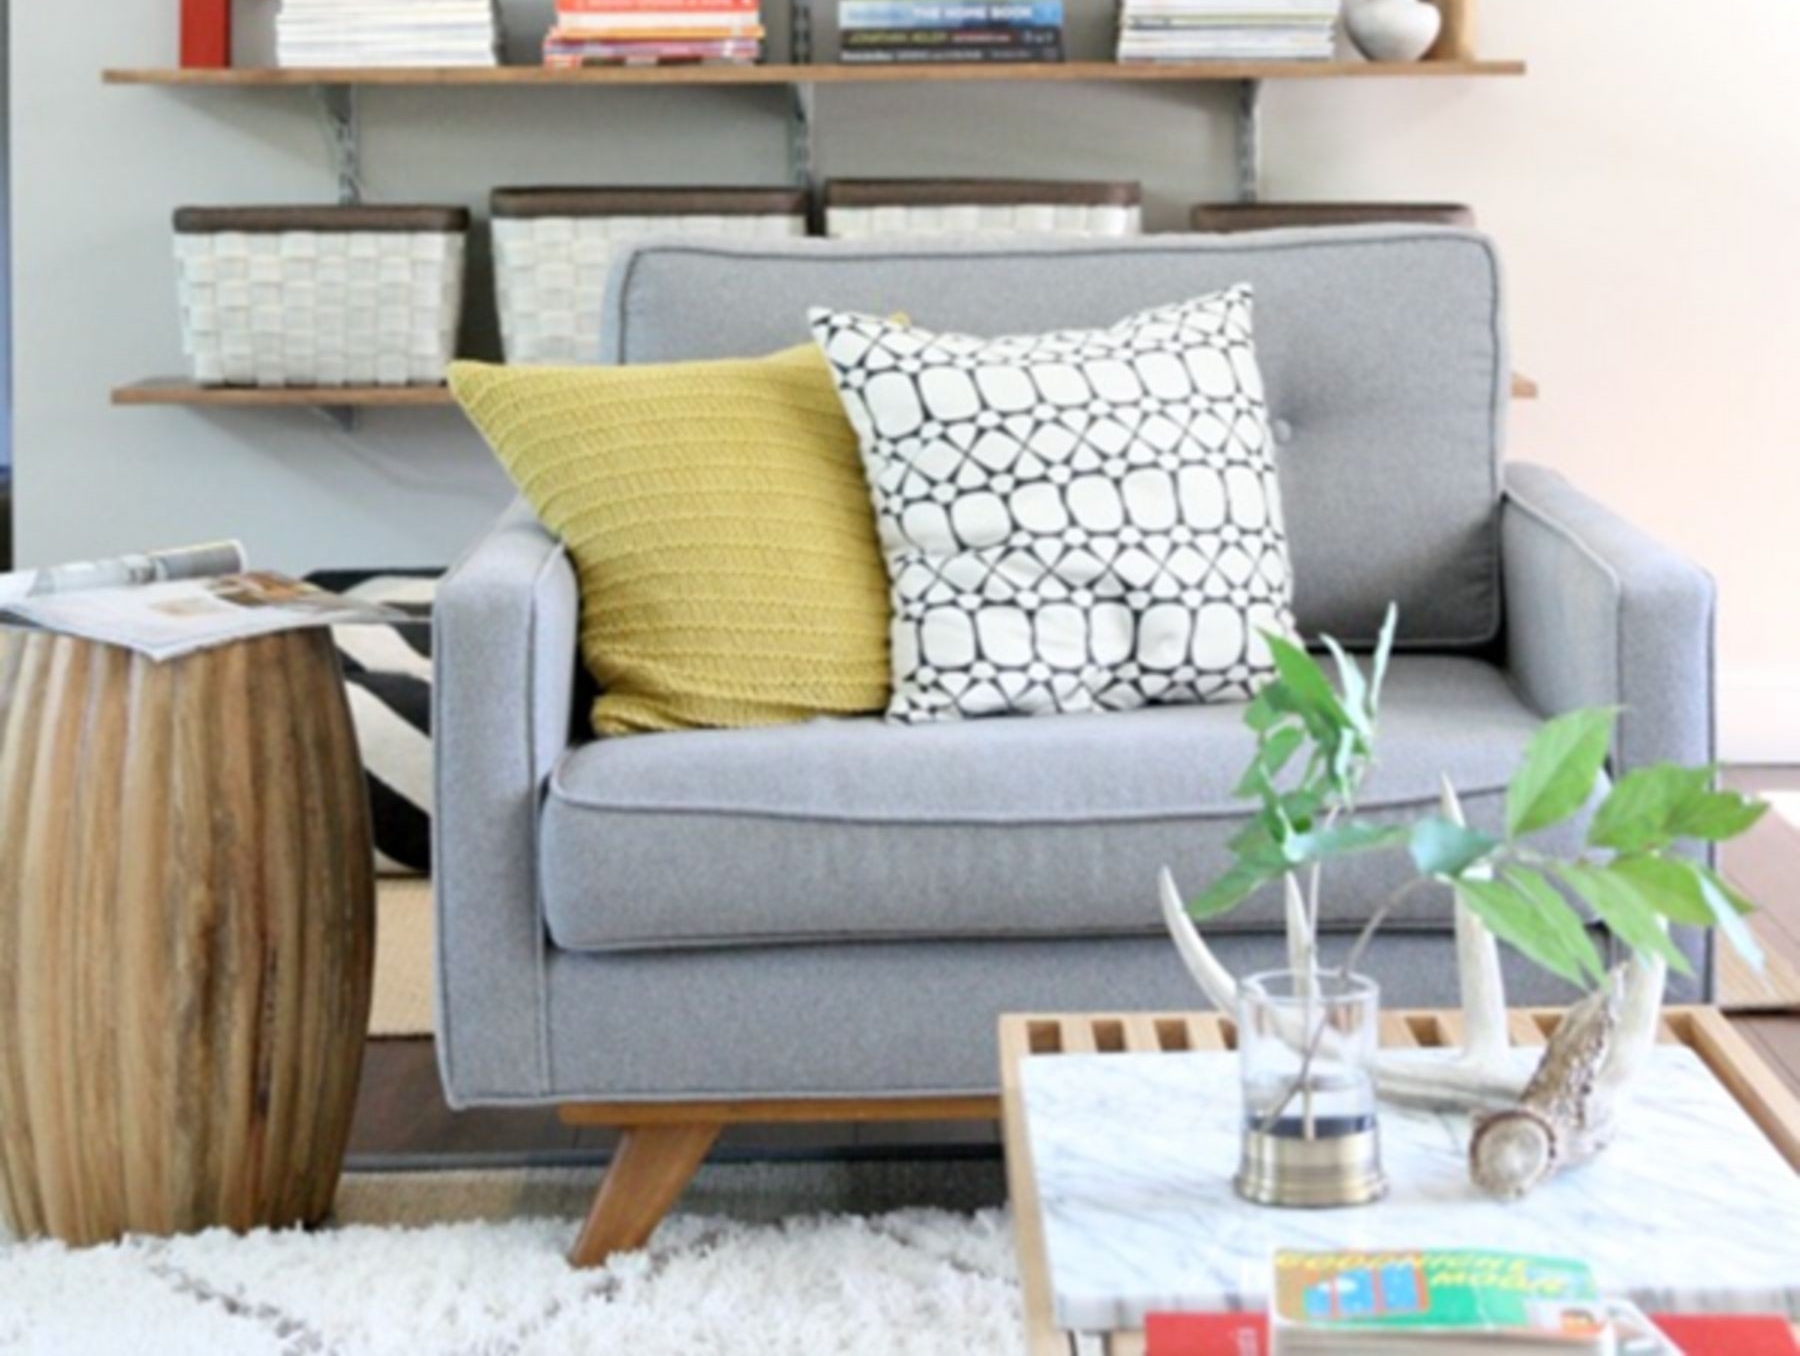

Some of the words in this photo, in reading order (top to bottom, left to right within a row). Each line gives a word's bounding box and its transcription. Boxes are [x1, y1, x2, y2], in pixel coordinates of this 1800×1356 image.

[912, 6, 940, 19] THE
[944, 6, 986, 19] HOME
[990, 5, 1032, 19] BOOK
